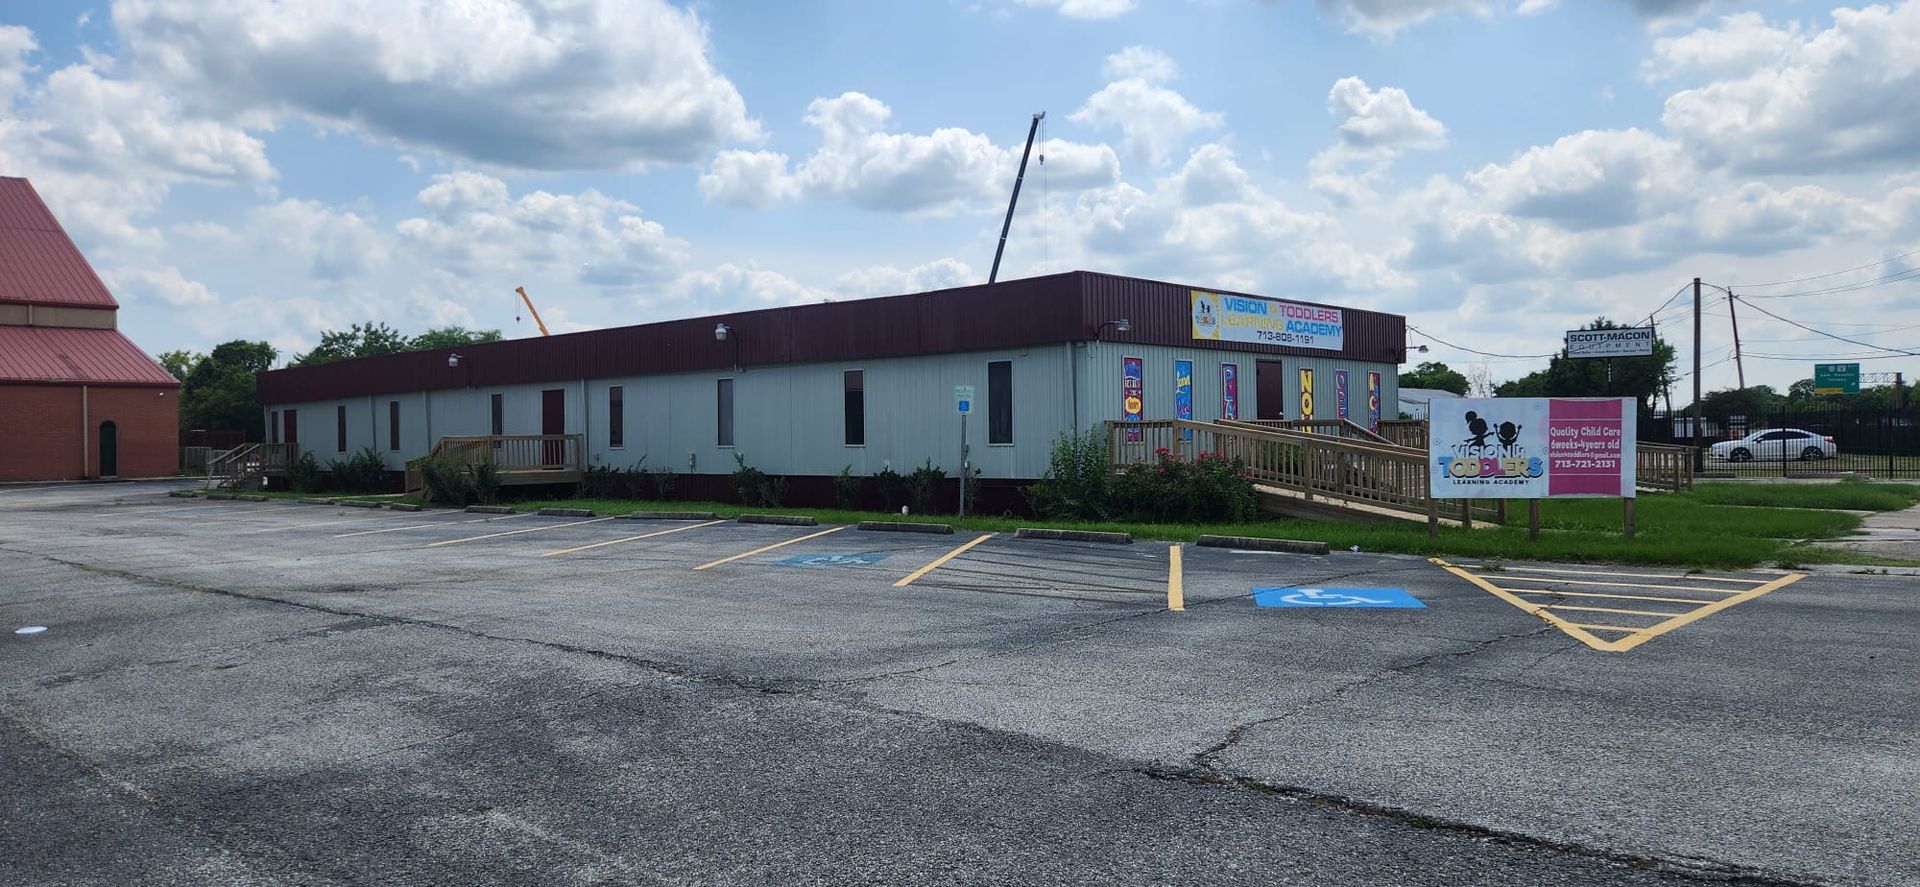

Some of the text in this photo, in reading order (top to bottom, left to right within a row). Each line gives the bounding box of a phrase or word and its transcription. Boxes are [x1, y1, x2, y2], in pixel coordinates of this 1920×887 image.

[1224, 298, 1267, 315] VISION
[1280, 304, 1339, 323] TODDLERS
[1221, 314, 1284, 331] LEARNING
[1286, 320, 1342, 337] ACADEMY
[1257, 331, 1314, 344] 713-808-1191
[1550, 426, 1620, 438] Quality Child Care
[1607, 439, 1620, 448] old
[1451, 444, 1512, 458] VISION
[1438, 457, 1543, 478] TODDLERS
[1555, 460, 1615, 468] 713-721-2131
